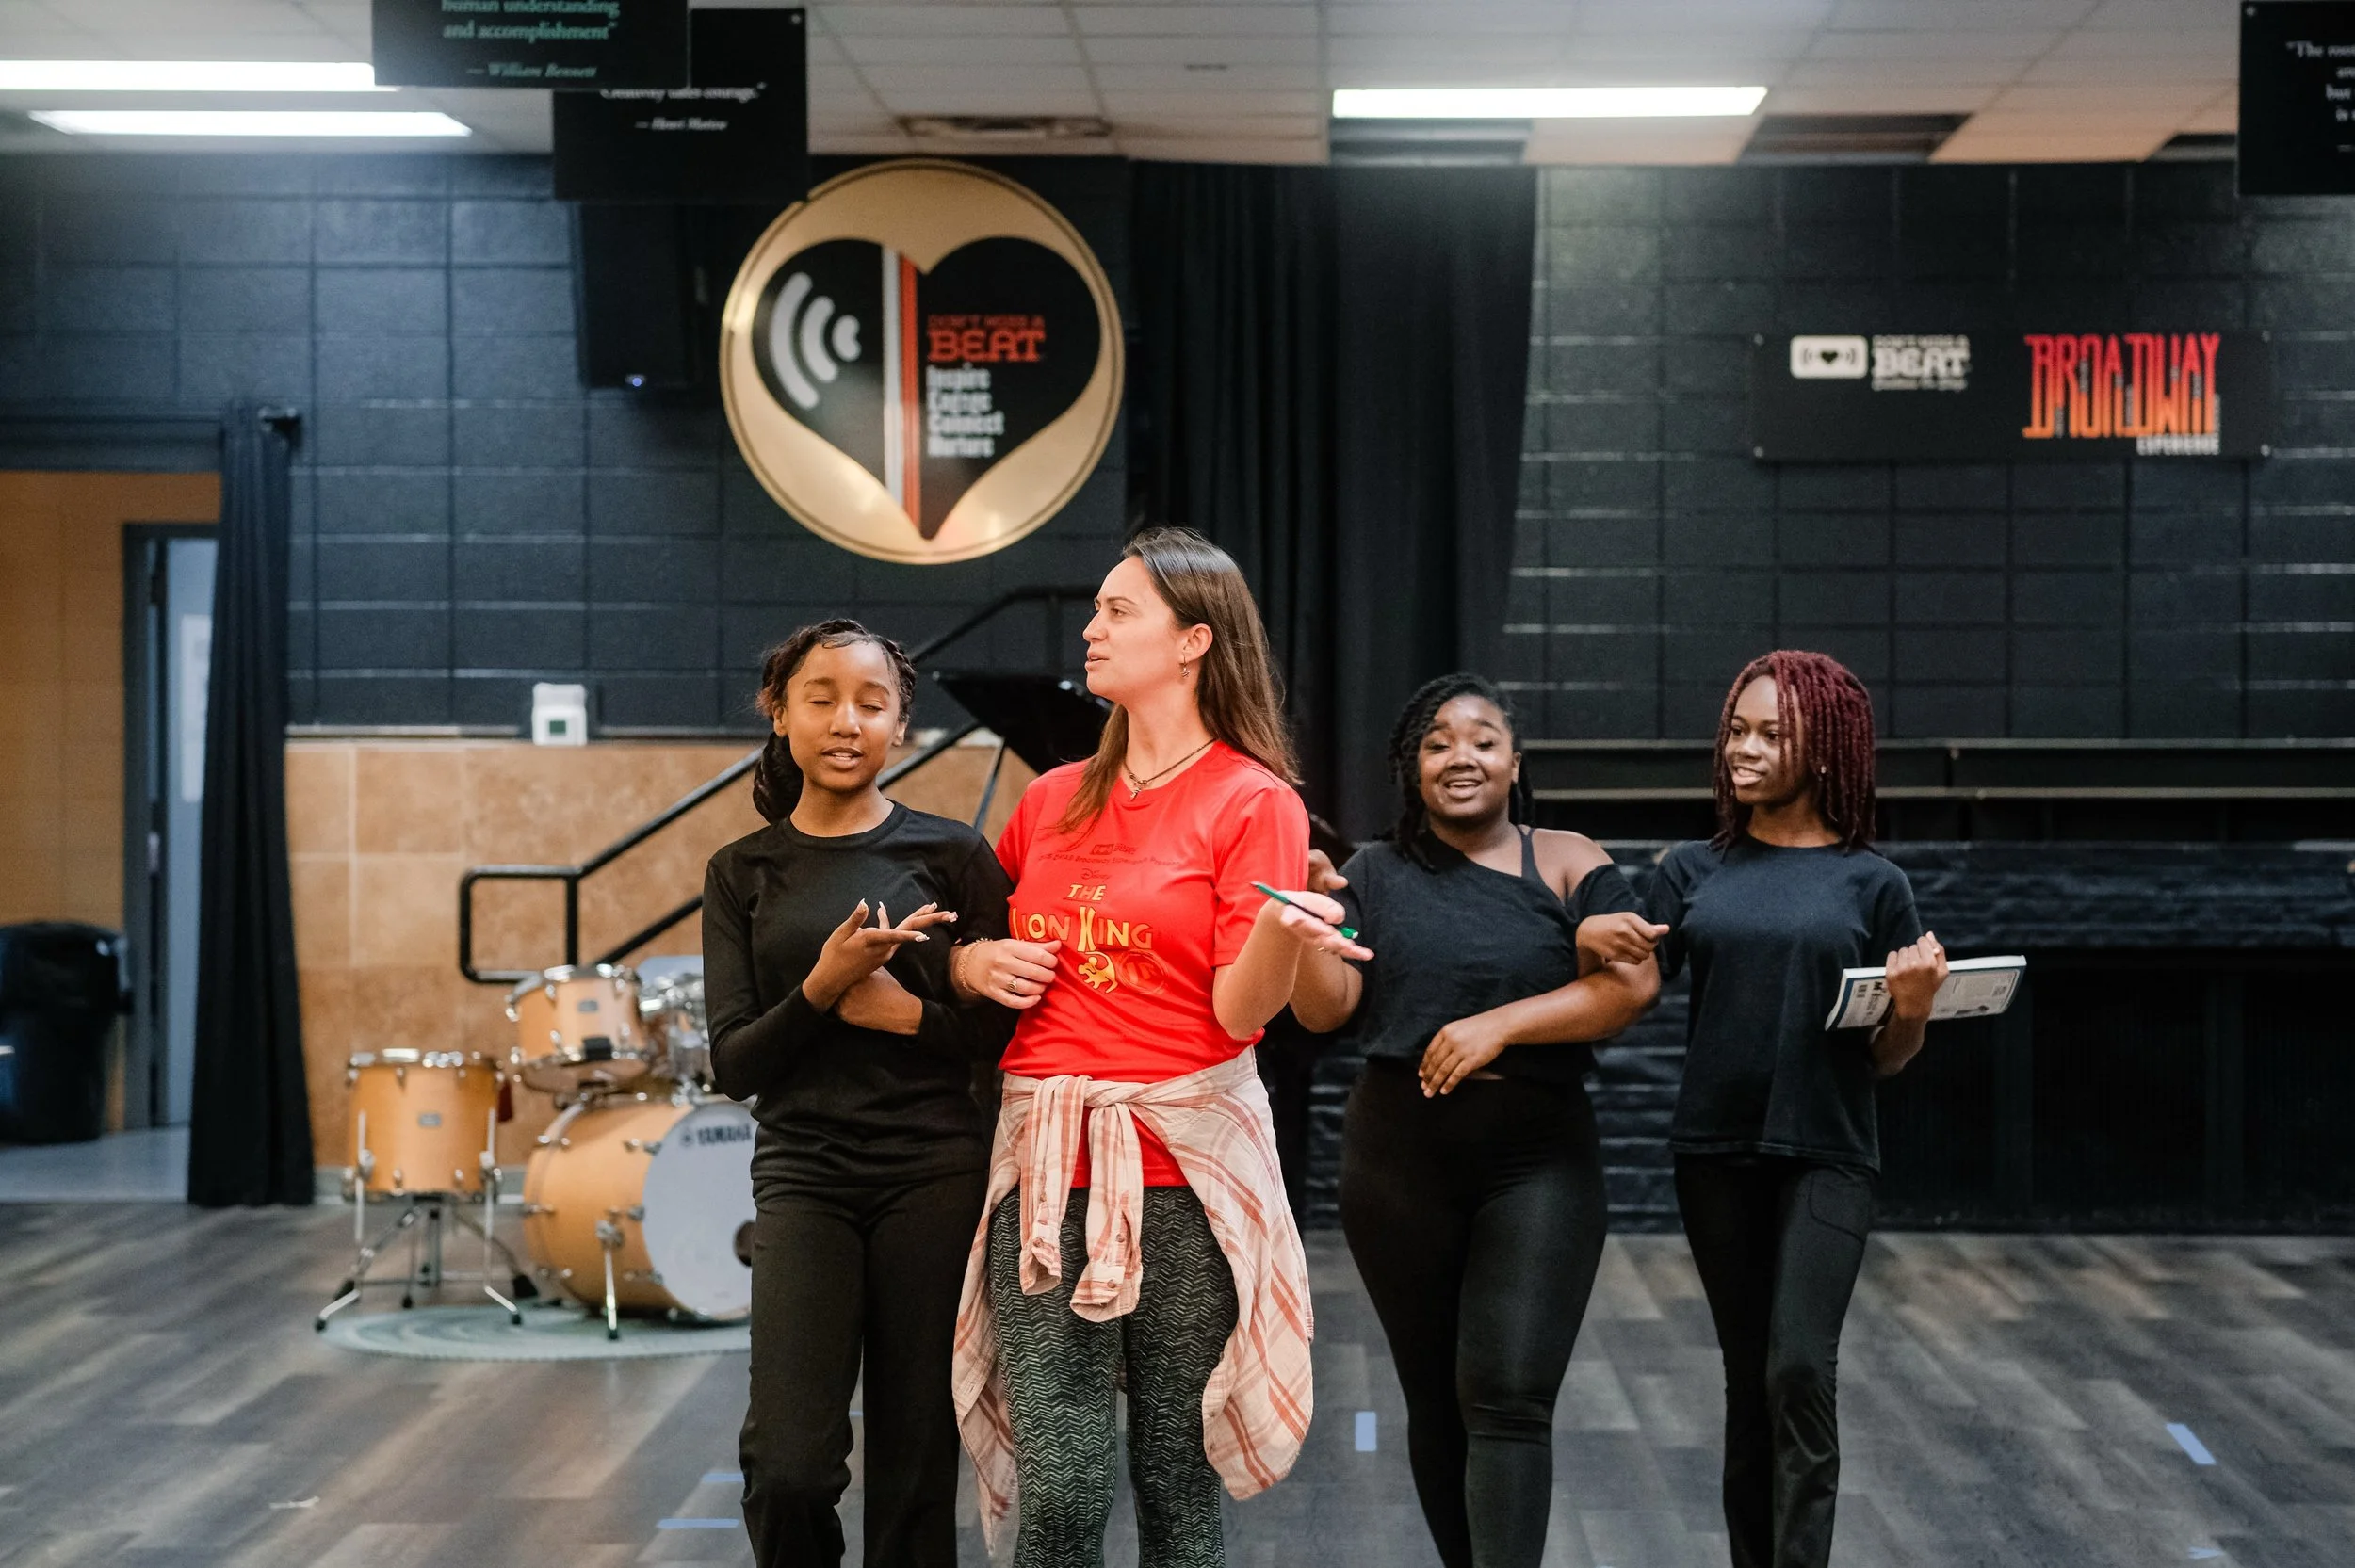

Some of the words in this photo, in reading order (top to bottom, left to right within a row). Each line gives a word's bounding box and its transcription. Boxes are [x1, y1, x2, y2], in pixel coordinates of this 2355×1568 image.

[441, 0, 499, 12] human
[503, 0, 620, 19] understanding
[443, 19, 475, 39] and
[927, 330, 1046, 362] BEAT
[1871, 347, 1971, 378] BEAT
[2022, 332, 2220, 438] BROADWAY
[927, 411, 1004, 435] Connect
[1067, 883, 1107, 901] THE
[1012, 907, 1071, 942] LION
[1077, 906, 1153, 952] KING
